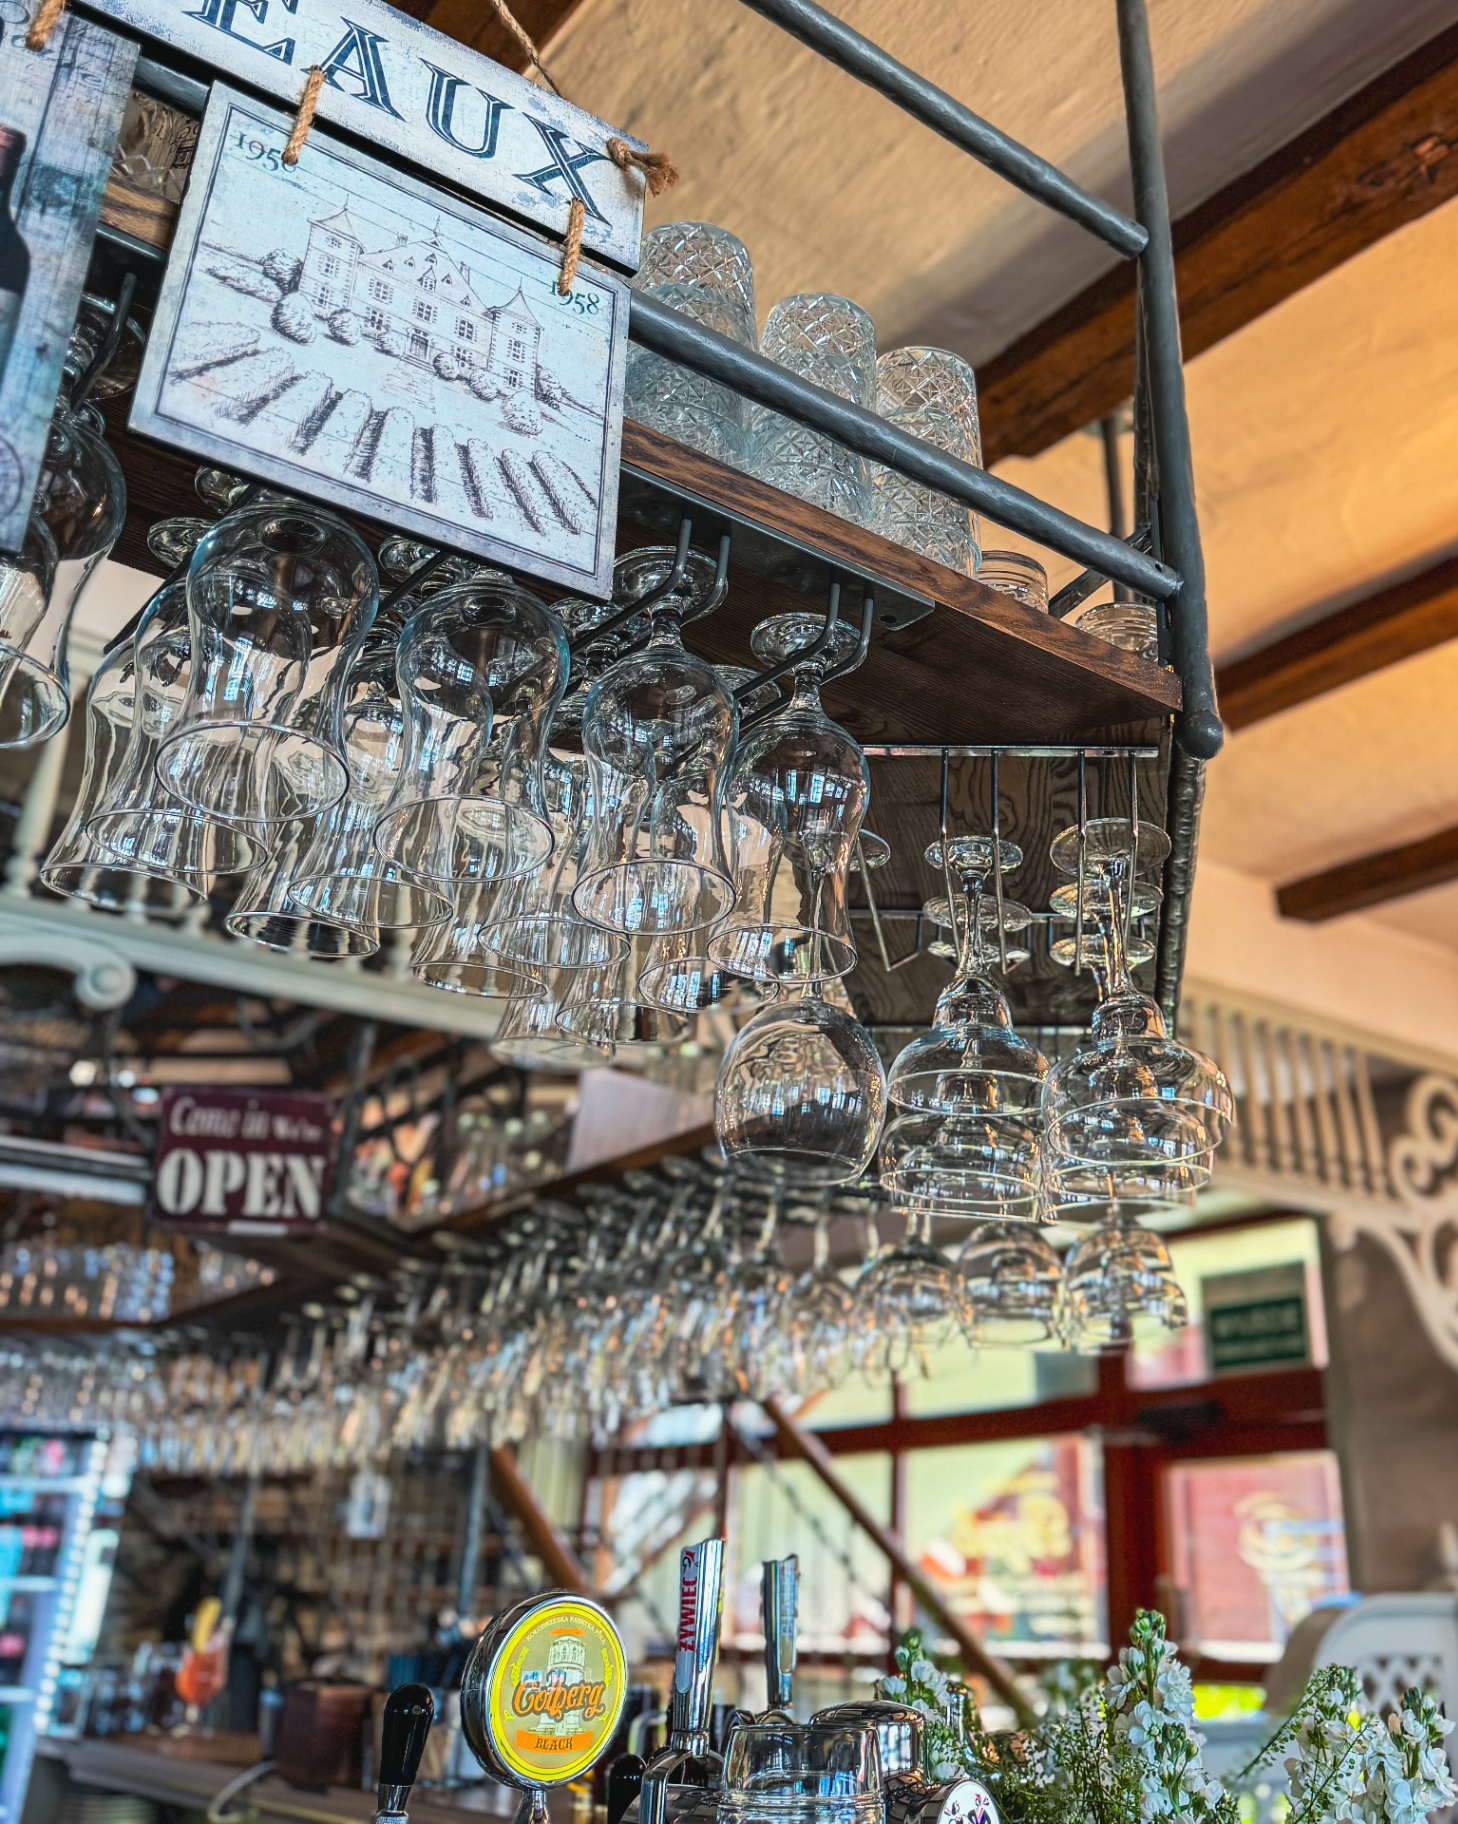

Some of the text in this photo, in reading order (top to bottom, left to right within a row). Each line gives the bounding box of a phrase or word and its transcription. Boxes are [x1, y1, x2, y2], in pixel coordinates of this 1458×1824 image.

[182, 0, 612, 227] EAUX
[170, 1096, 241, 1138] Come
[242, 1099, 270, 1139] in
[157, 1147, 326, 1219] OPEN
[679, 1577, 697, 1652] ŻYWIEC
[512, 1673, 605, 1720] Colberg
[534, 1737, 574, 1751] BLACK
